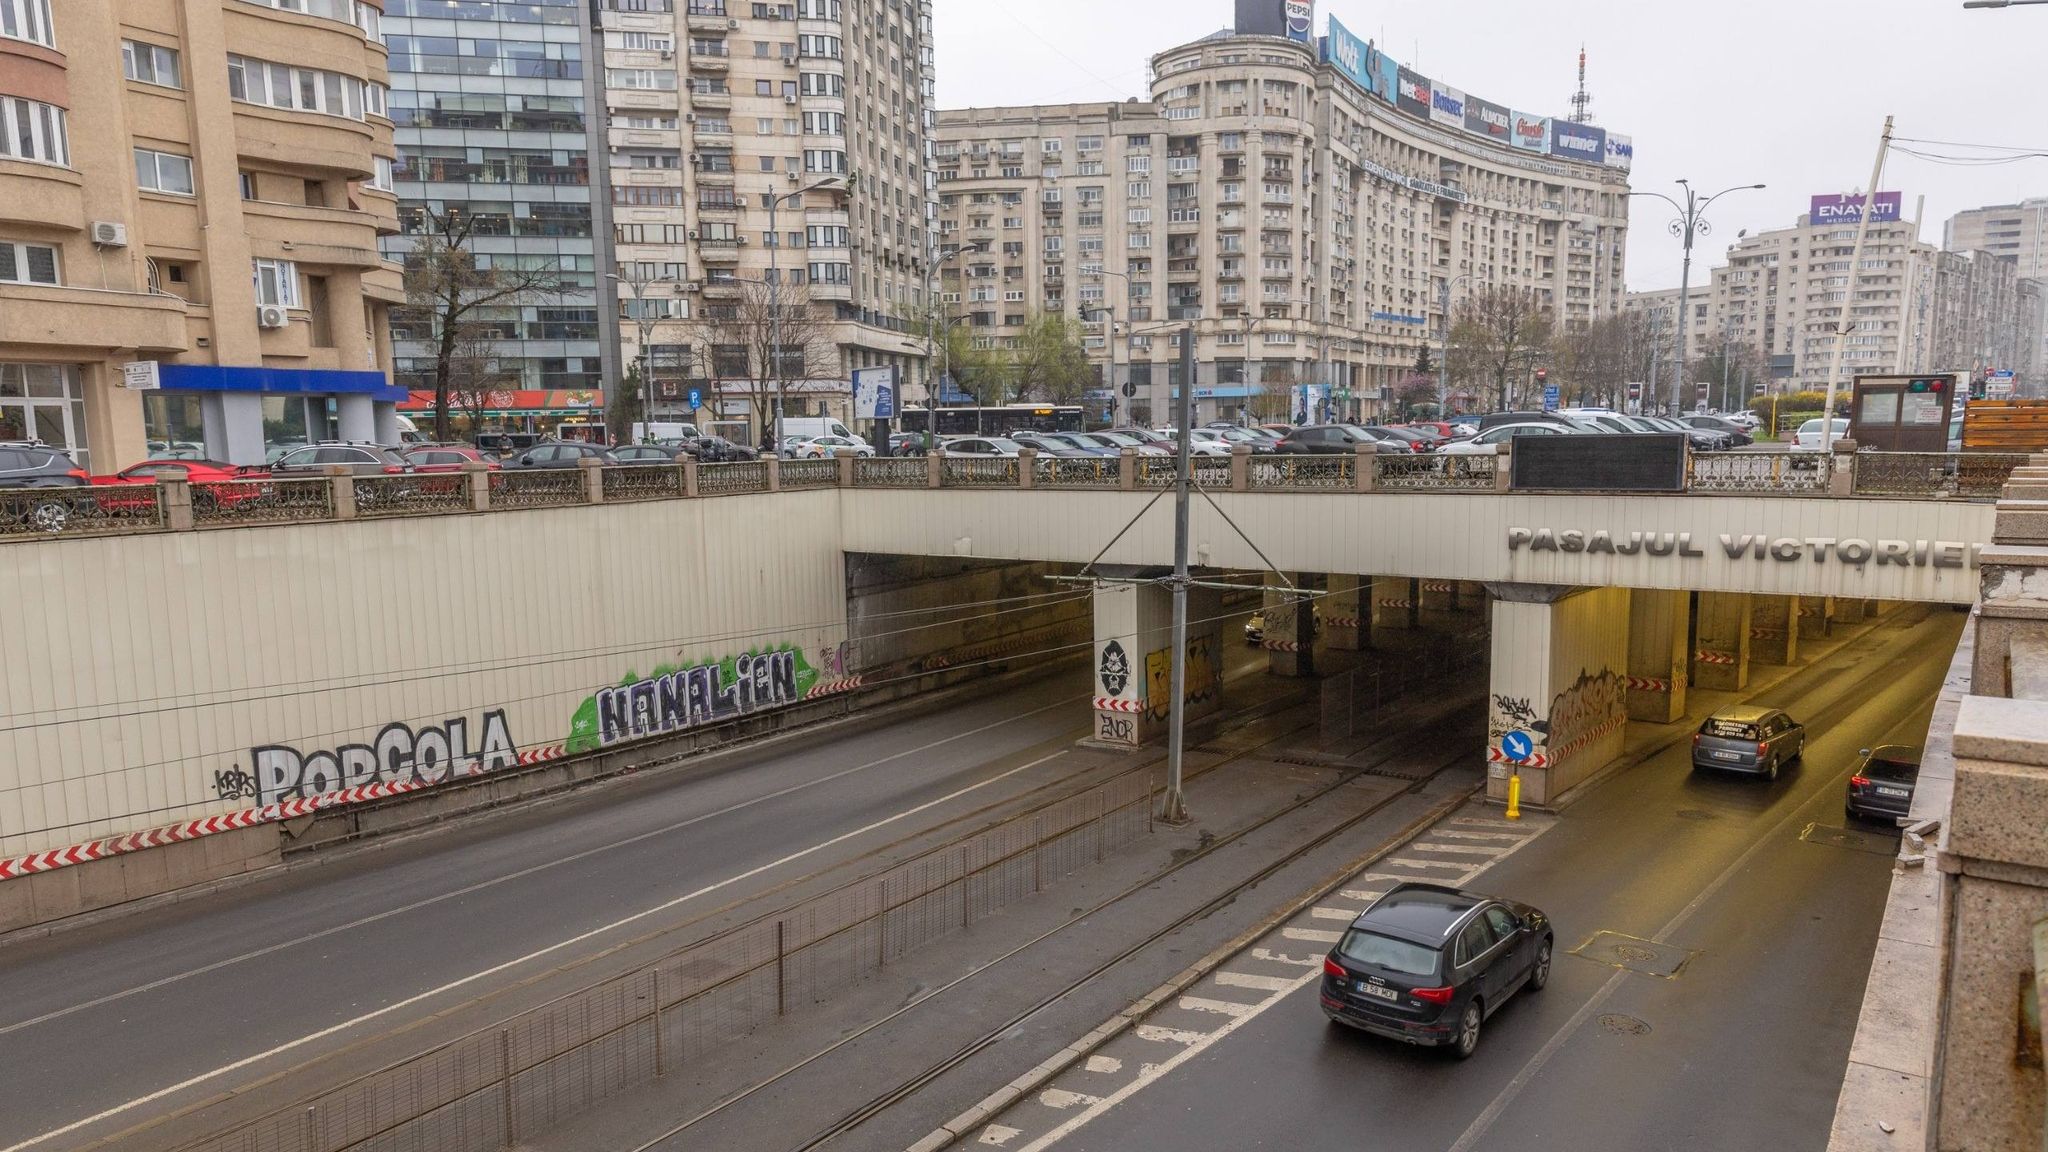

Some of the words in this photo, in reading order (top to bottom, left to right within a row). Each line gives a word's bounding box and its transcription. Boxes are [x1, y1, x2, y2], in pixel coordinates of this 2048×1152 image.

[1287, 3, 1310, 17] PEPSI
[1559, 132, 1599, 152] winner
[1819, 203, 1893, 217] ENAYATI
[1508, 527, 1704, 557] PASAJUL
